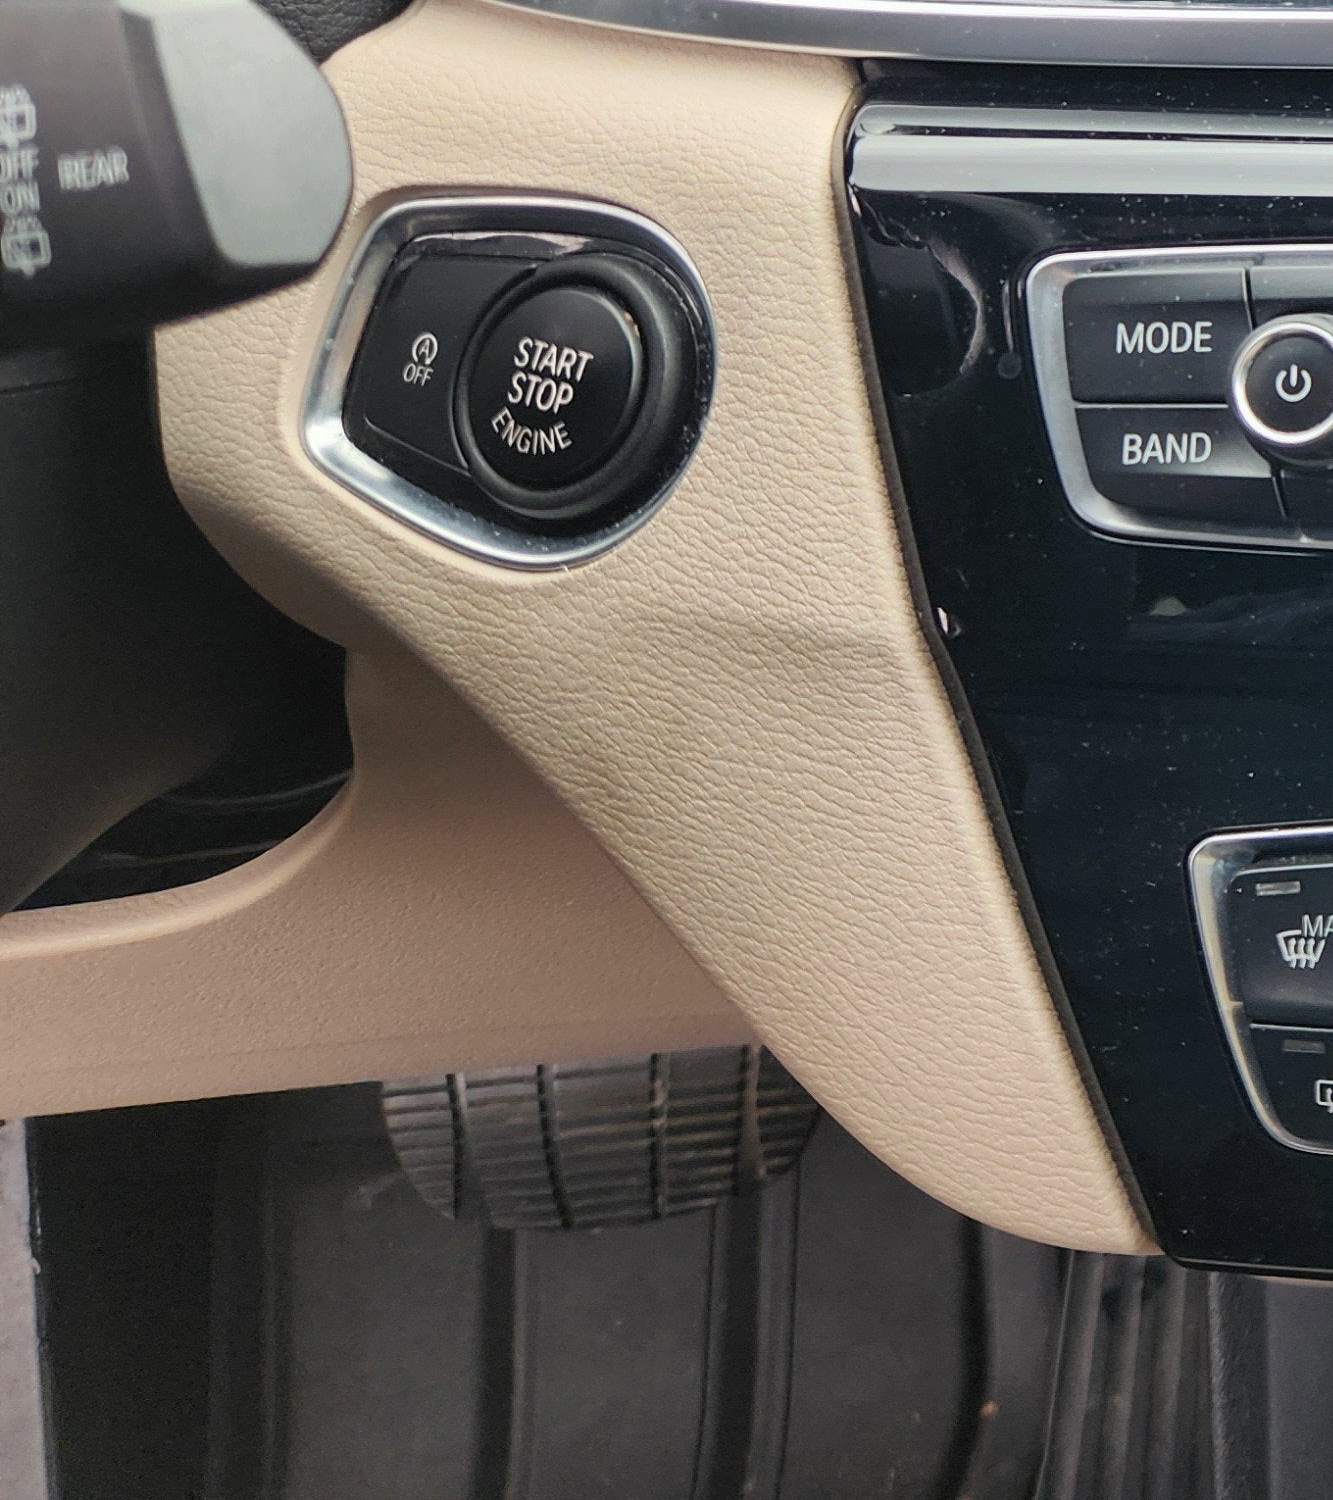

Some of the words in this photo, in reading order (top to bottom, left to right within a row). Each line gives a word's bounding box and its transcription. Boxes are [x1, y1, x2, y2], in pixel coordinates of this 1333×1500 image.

[57, 146, 130, 190] REAR
[1115, 320, 1212, 354] MODE
[403, 362, 434, 387] OFF
[514, 337, 593, 383] START
[508, 375, 573, 416] STOP
[491, 406, 573, 455] ENGINE
[1121, 432, 1212, 466] BAND
